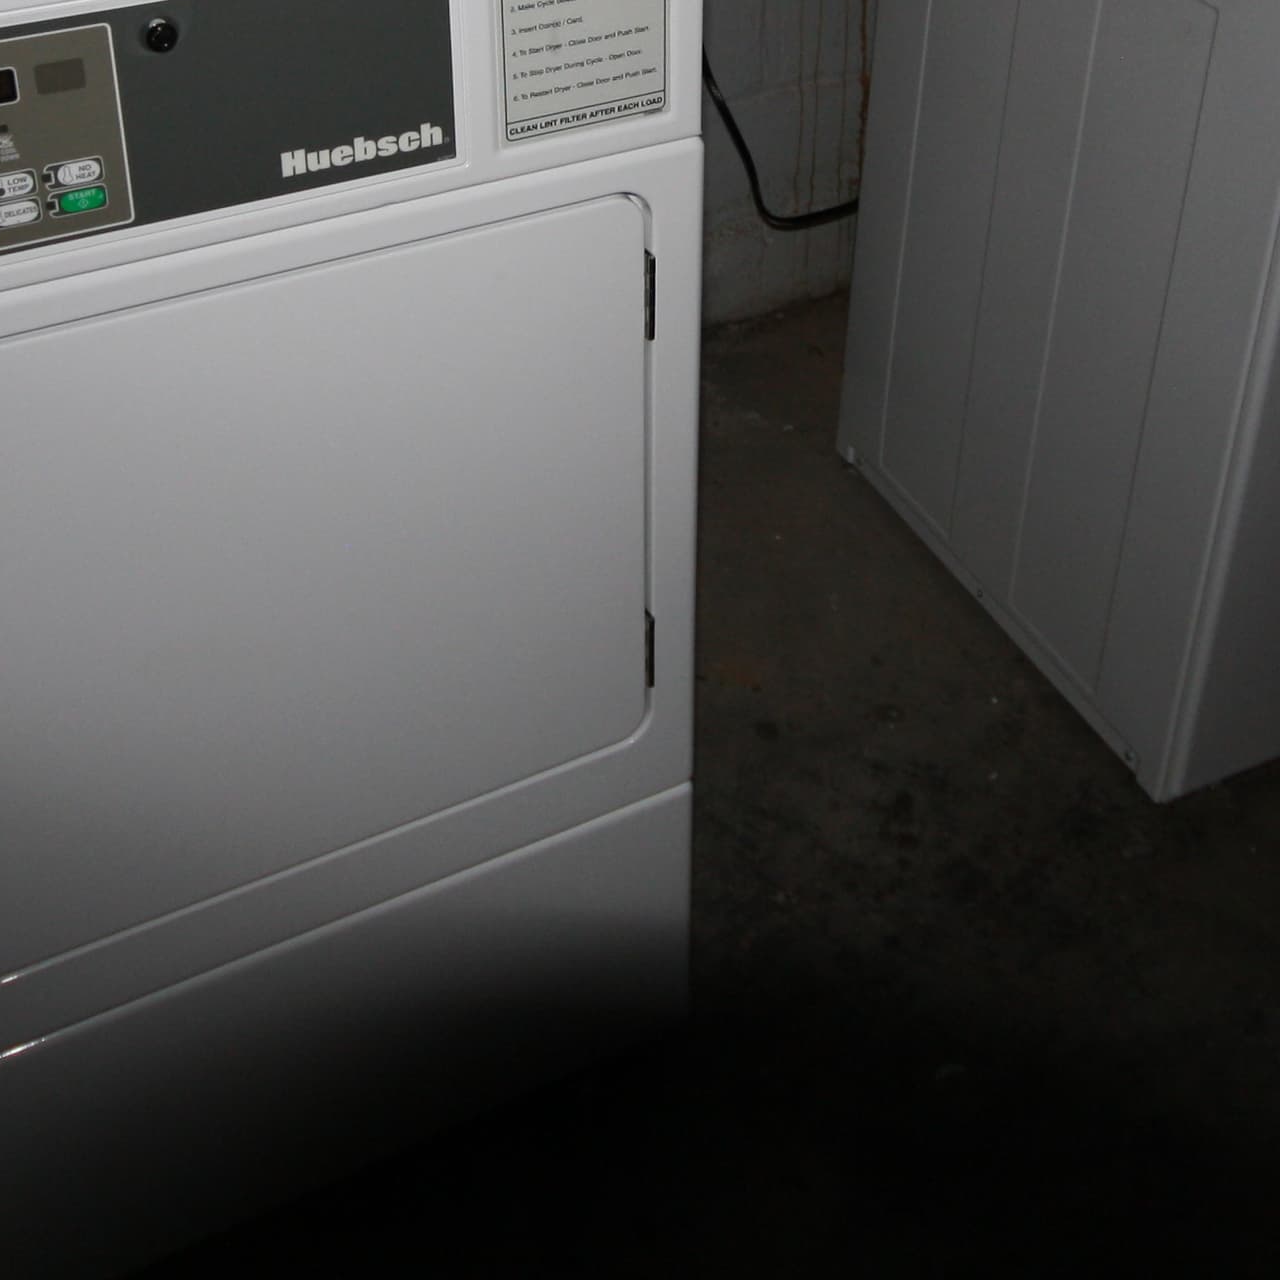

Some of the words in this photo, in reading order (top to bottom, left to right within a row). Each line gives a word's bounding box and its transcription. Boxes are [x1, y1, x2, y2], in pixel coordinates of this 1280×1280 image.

[537, 0, 554, 8] Cycle
[529, 46, 544, 55] Start
[545, 43, 562, 52] Dryer
[568, 39, 586, 47] Close
[617, 28, 632, 36] Push
[529, 69, 544, 77] Stop
[545, 65, 562, 73] Dryer
[564, 61, 584, 70] During
[586, 57, 603, 65] Cycle
[609, 53, 625, 61] Open
[530, 89, 552, 98] Restart
[554, 85, 571, 94] Dryer
[576, 81, 594, 89] Close
[625, 71, 640, 79] Push
[509, 123, 538, 135] CLEAN
[540, 119, 557, 129] LINT
[560, 113, 587, 125] FILTER
[589, 107, 615, 118] AFTER
[617, 101, 639, 112] EACH
[641, 96, 663, 107] LOAD
[280, 122, 443, 178] Huebsch
[78, 164, 92, 172] NO
[76, 171, 97, 180] HEAT
[7, 177, 28, 186] LOW
[8, 183, 29, 193] TEMP
[69, 189, 97, 200] START
[4, 206, 38, 218] DELICATES
